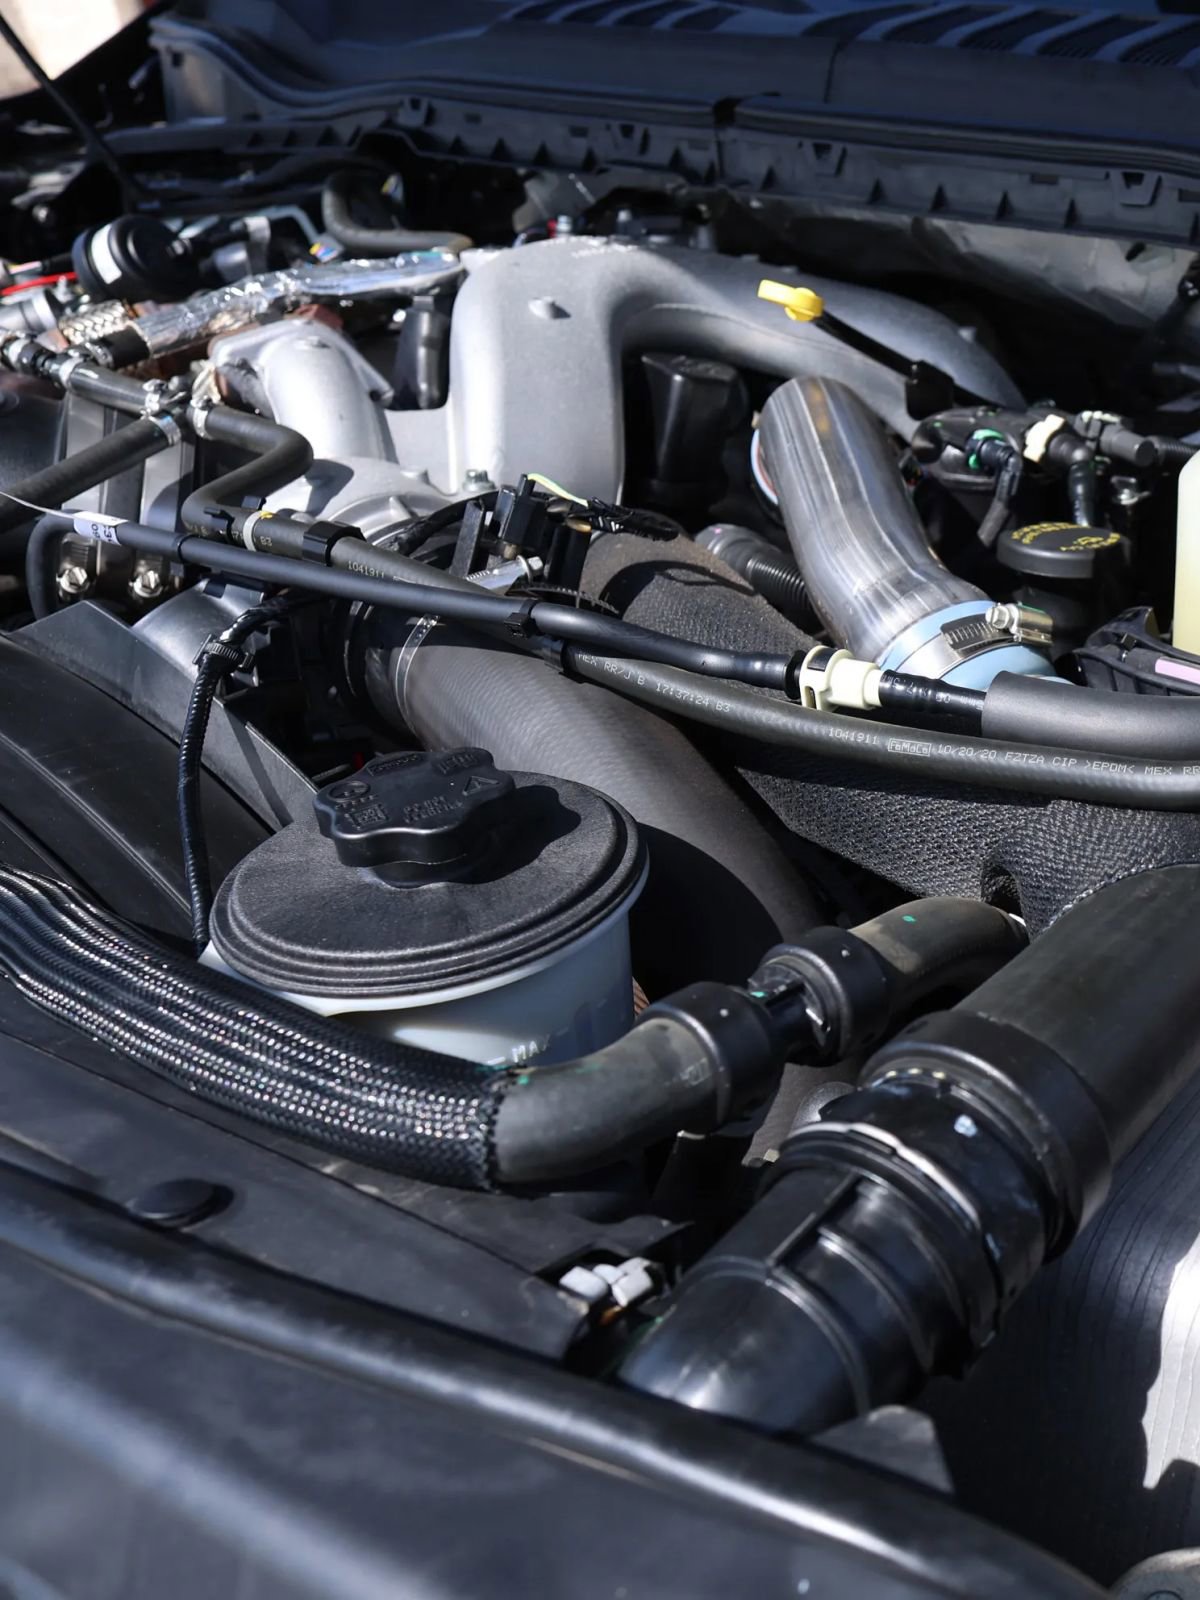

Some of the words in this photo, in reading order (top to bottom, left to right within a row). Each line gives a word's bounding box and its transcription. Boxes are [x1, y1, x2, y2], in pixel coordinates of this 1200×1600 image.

[655, 682, 710, 707] 17:37:24
[828, 727, 878, 745] 1041911
[938, 744, 997, 760] 10/20/20
[1052, 756, 1077, 768] CIP
[1144, 765, 1173, 776] MEX
